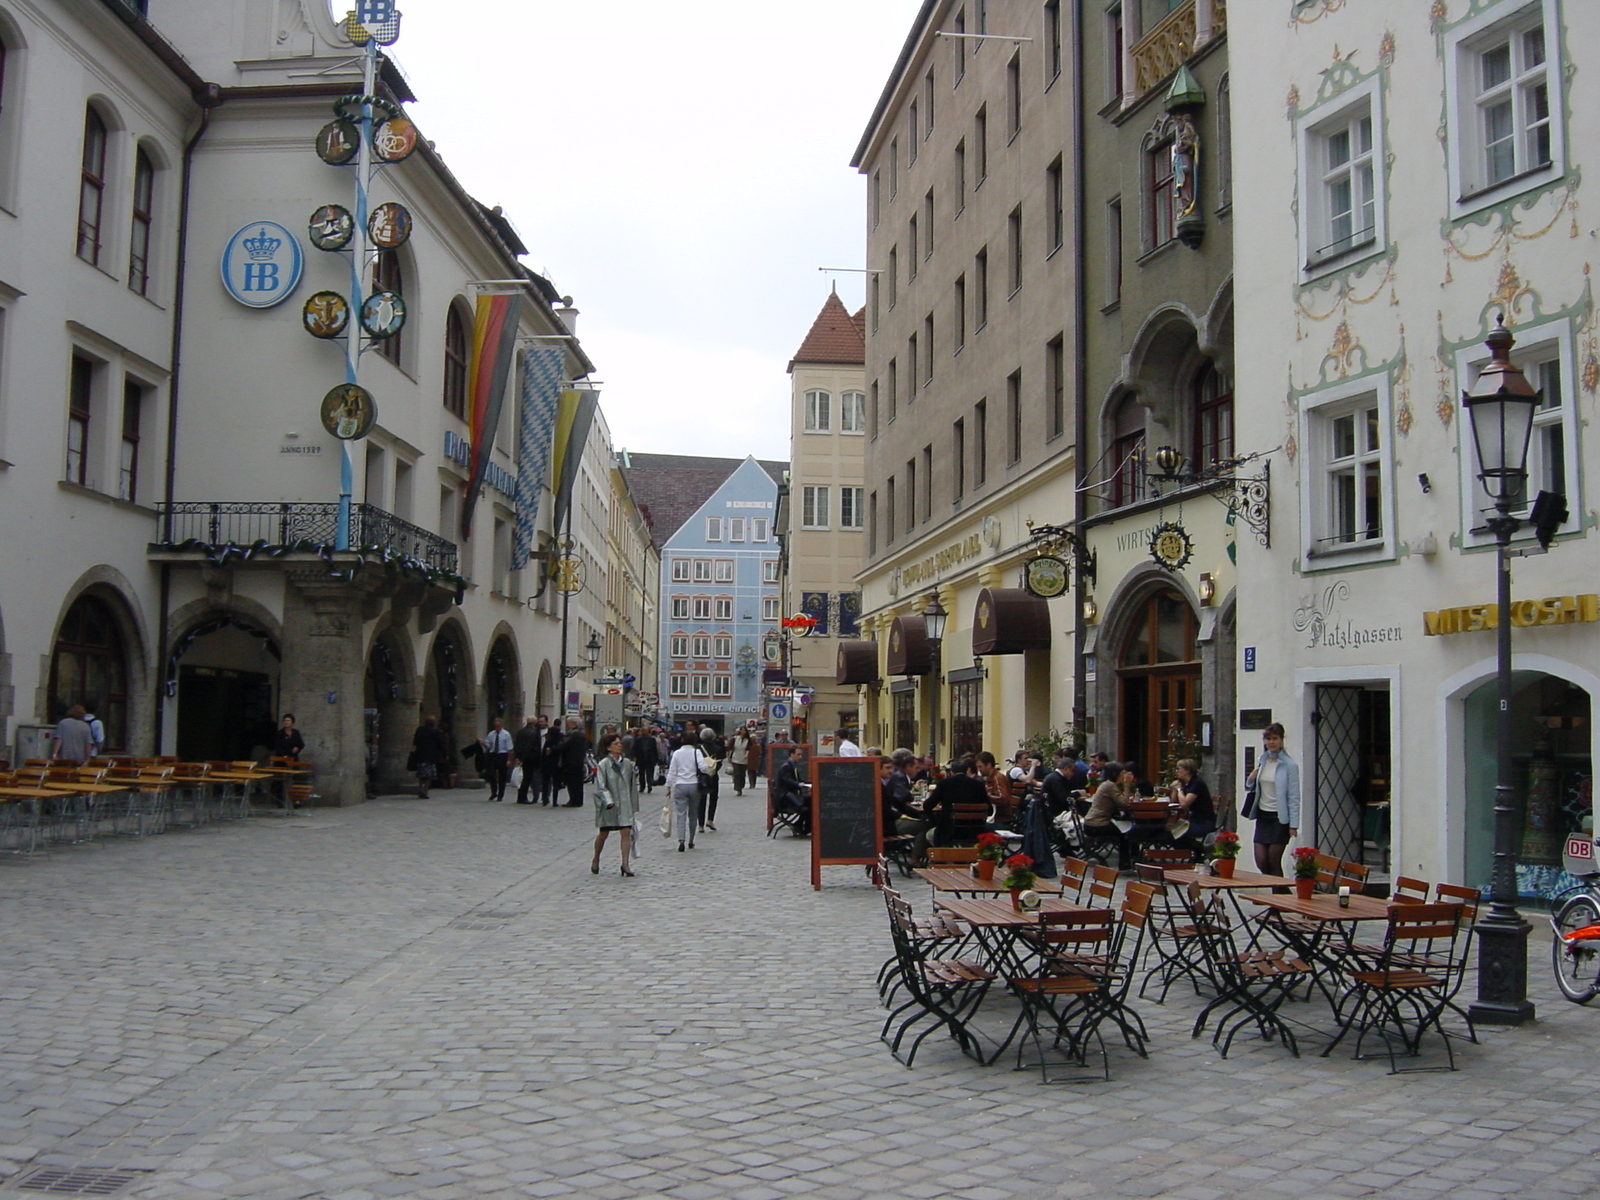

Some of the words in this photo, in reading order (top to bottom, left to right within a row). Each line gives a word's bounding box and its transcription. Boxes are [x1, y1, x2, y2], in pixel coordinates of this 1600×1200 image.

[242, 263, 279, 291] HB
[1299, 609, 1403, 649] Platzlgassen
[674, 701, 723, 712] böhmler
[1571, 842, 1589, 856] DB
